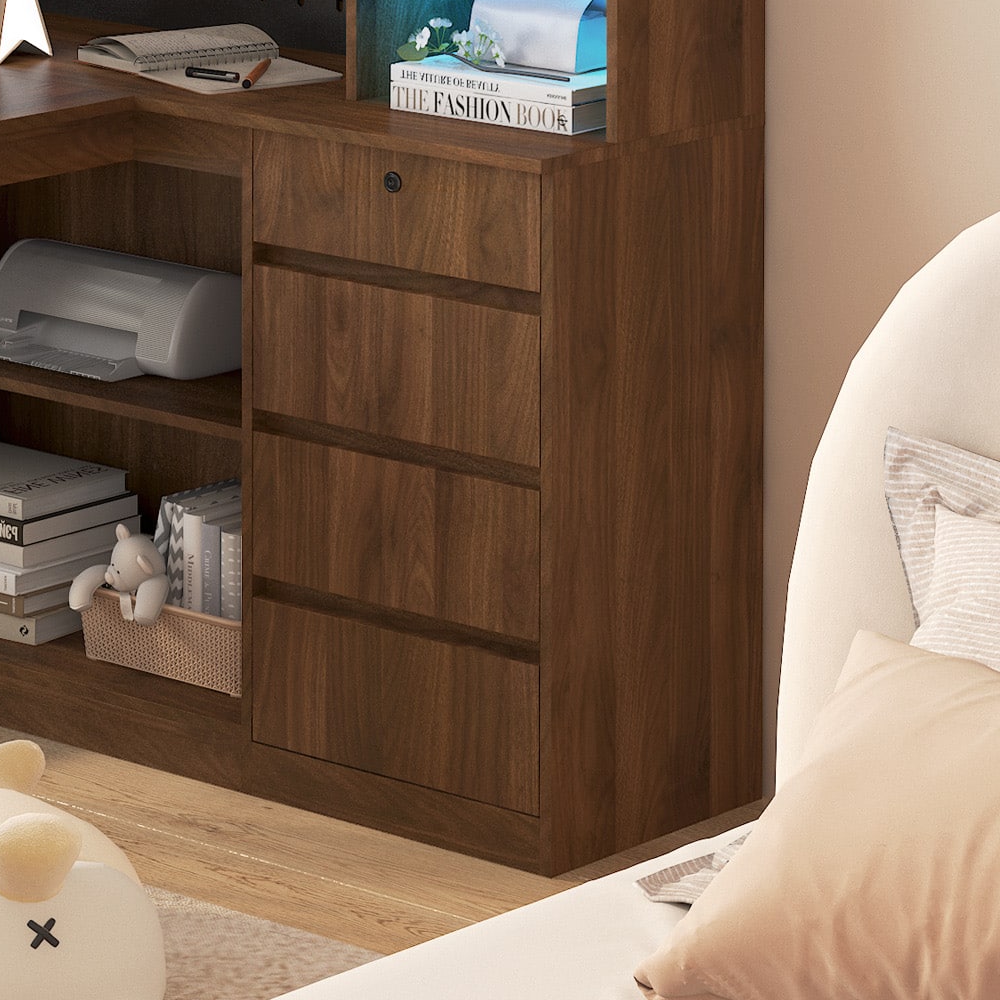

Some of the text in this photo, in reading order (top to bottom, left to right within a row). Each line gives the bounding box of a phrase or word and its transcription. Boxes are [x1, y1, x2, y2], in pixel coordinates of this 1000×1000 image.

[392, 86, 568, 133] THE FASHION BOOK
